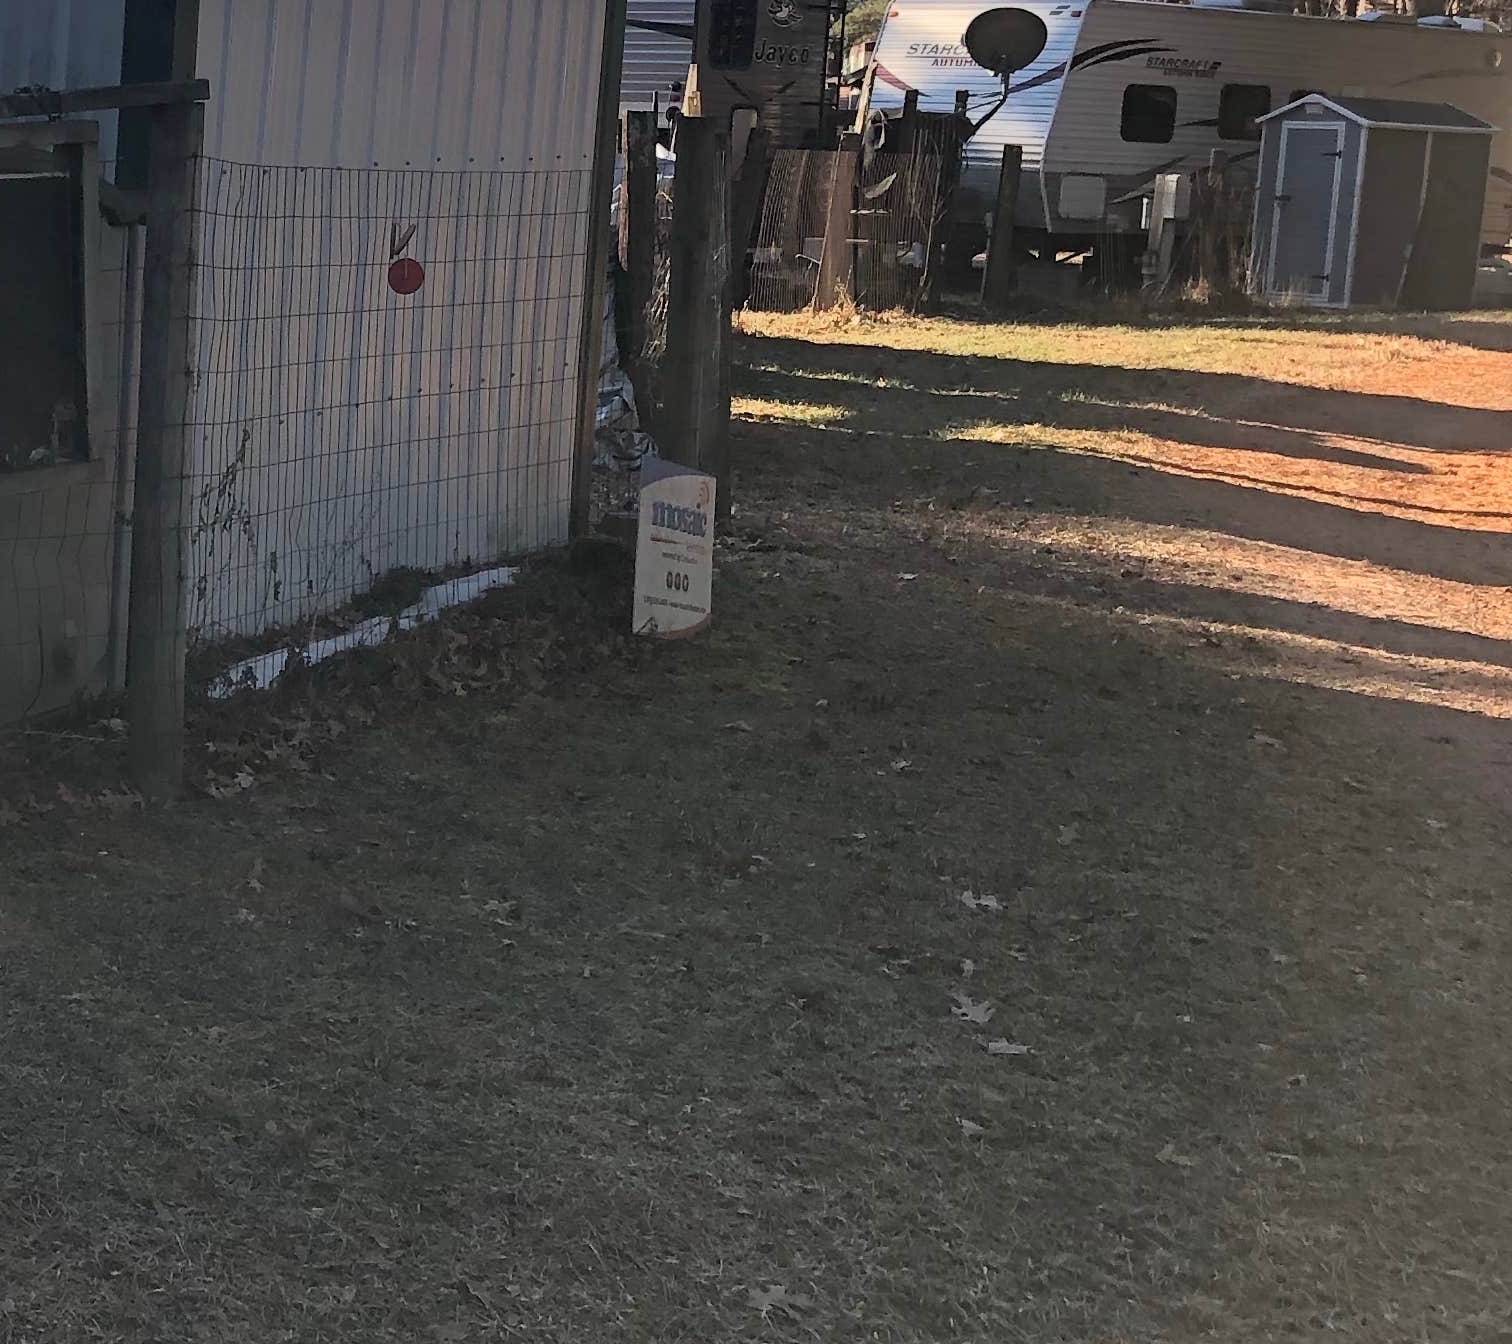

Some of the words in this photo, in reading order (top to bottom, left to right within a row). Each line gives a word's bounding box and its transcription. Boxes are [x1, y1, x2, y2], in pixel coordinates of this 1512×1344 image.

[754, 37, 810, 69] Jayco
[906, 43, 972, 56] STARC
[1145, 56, 1209, 71] STARCRAFT
